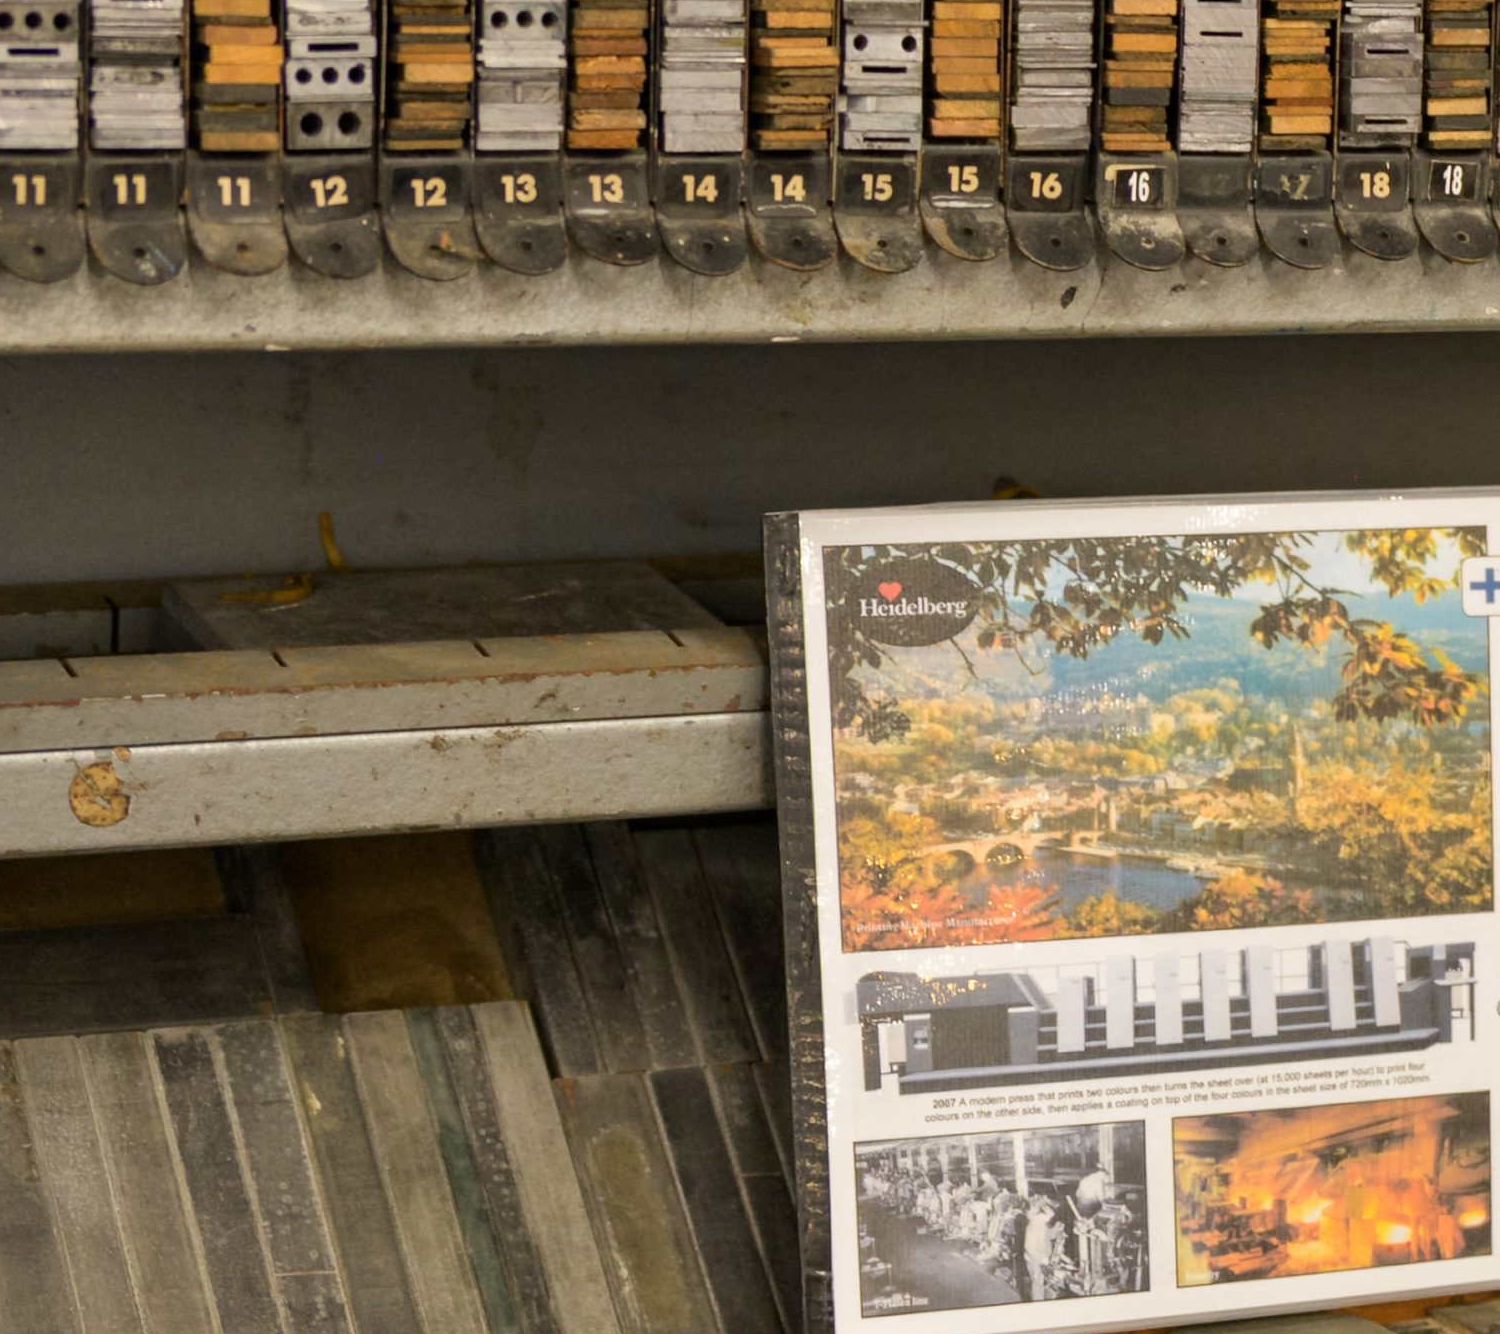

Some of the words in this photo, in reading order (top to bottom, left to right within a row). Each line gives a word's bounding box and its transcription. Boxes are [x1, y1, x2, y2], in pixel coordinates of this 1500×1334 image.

[11, 174, 47, 206] 11
[113, 173, 147, 205] 11
[217, 176, 251, 207] 11
[310, 176, 349, 208] 12
[411, 177, 447, 207] 12
[501, 173, 537, 204] 13
[588, 173, 625, 204] 13
[682, 174, 718, 203] 14
[770, 174, 806, 203] 14
[861, 173, 893, 202] 15
[947, 165, 979, 193] 15
[1029, 171, 1063, 199] 16
[1127, 169, 1151, 203] 16
[1360, 171, 1391, 199] 18
[1442, 165, 1463, 195] 18
[859, 596, 968, 619] Heidelberg
[857, 921, 899, 933] Printing
[925, 1112, 959, 1123] colours
[962, 1110, 974, 1120] on
[977, 1108, 992, 1119] the
[995, 1106, 1019, 1118] other
[1022, 1104, 1045, 1116] side,
[1048, 1102, 1068, 1113] then
[1071, 1100, 1103, 1113] applies
[1106, 1101, 1113, 1109] a
[1115, 1097, 1149, 1110] coating
[1151, 1096, 1163, 1106] on
[1166, 1094, 1180, 1106] top
[1183, 1091, 1192, 1102] of
[1194, 1090, 1208, 1101] the
[1211, 1089, 1228, 1100] four
[1231, 1087, 1263, 1099] colours
[1266, 1086, 1274, 1096] in
[1276, 1085, 1290, 1096] the
[1293, 1083, 1317, 1094] sheet
[1320, 1081, 1337, 1092] size
[1339, 1080, 1348, 1090] of
[1350, 1078, 1383, 1089] 720mm
[933, 1098, 956, 1109] 2007
[959, 1097, 967, 1107] A
[969, 1095, 1006, 1107] modern
[1008, 1094, 1035, 1105] press
[1038, 1091, 1056, 1101] that
[1058, 1089, 1084, 1101] prints
[1086, 1088, 1102, 1098] two
[1105, 1086, 1139, 1097] colours
[1141, 1083, 1162, 1094] then
[1165, 1081, 1187, 1091] turns
[1190, 1079, 1204, 1089] the
[1207, 1077, 1232, 1088] sheet
[1234, 1076, 1254, 1086] over
[1256, 1074, 1269, 1086] (at
[1272, 1072, 1301, 1083] 15,000
[1303, 1069, 1332, 1081] sheets
[1334, 1068, 1349, 1079] per
[1352, 1066, 1374, 1078] hour)
[1376, 1065, 1385, 1074] to
[1387, 1063, 1406, 1075] print
[1408, 1062, 1425, 1071] four
